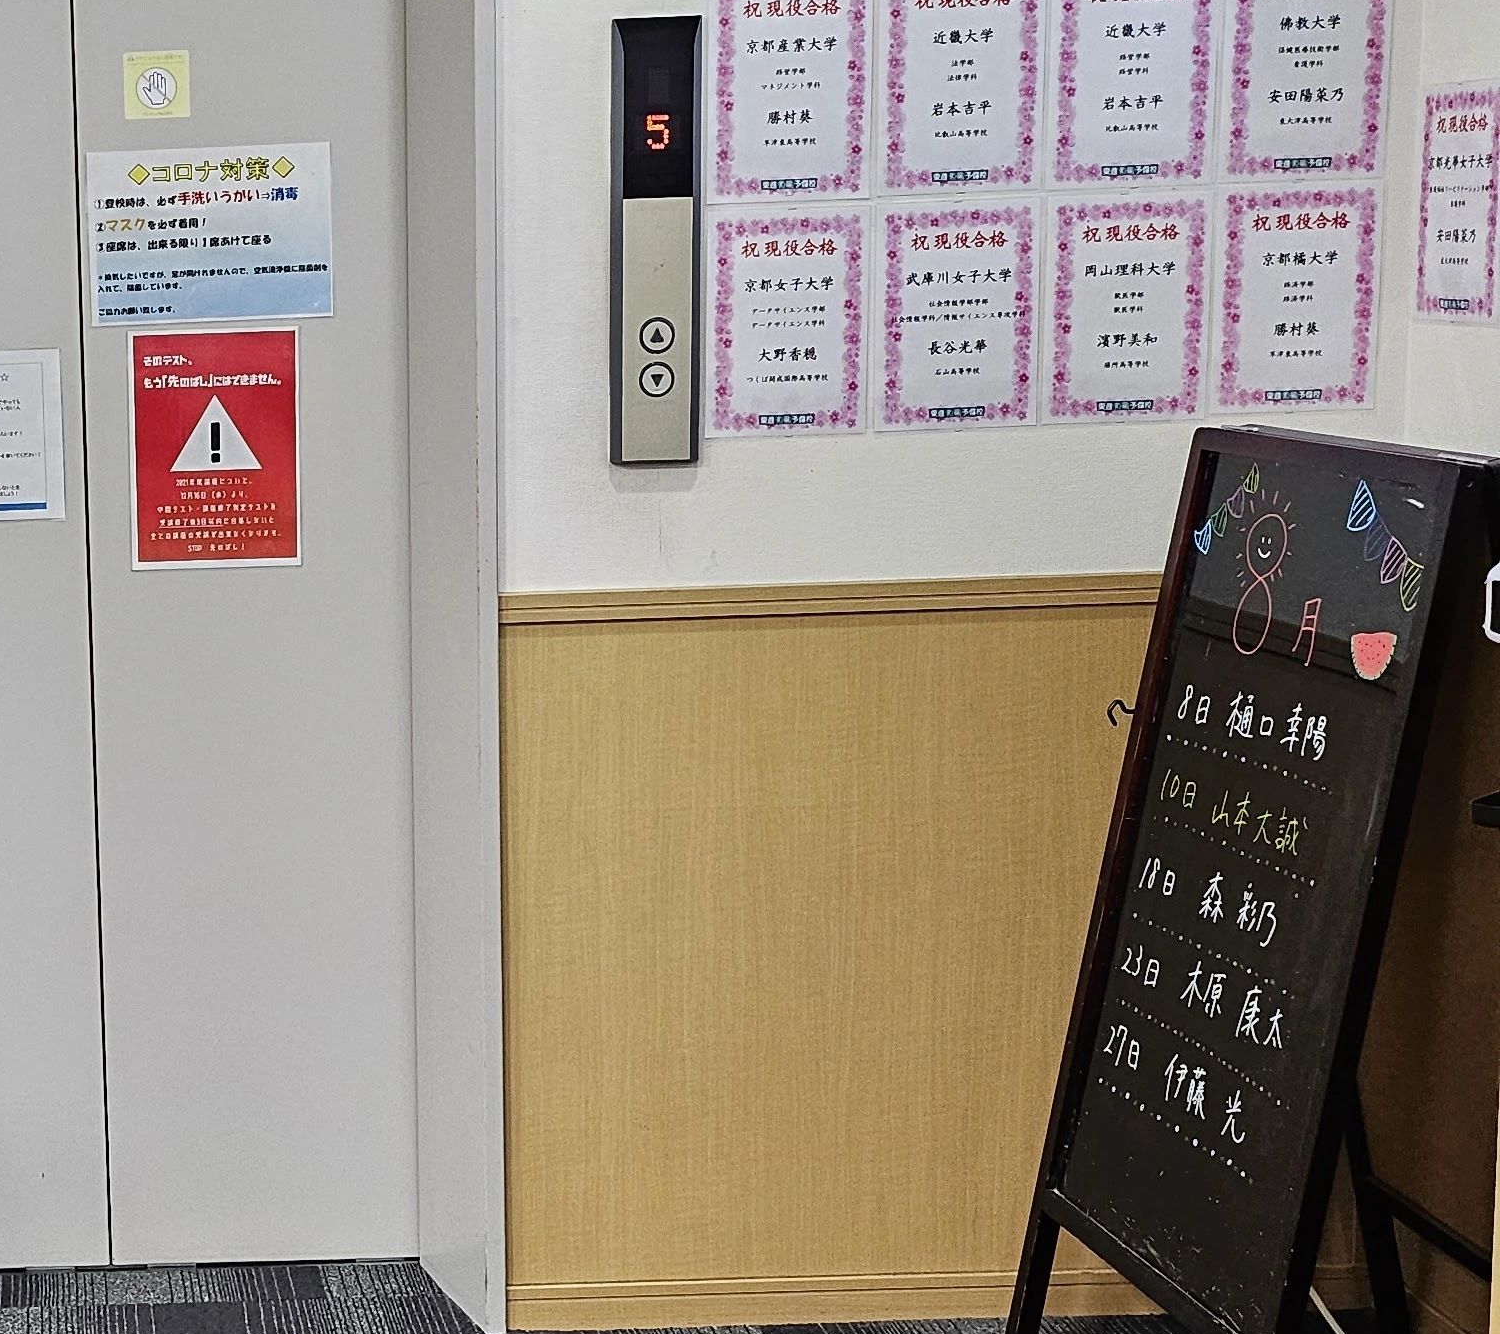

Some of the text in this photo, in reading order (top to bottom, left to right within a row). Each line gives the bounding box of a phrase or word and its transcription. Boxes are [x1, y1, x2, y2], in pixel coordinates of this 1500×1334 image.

[933, 28, 993, 44] 近畿大学
[1105, 22, 1166, 38] 近畿大学
[747, 36, 837, 54] 京都産業大学
[1102, 95, 1163, 110] 岩本吉平
[1268, 87, 1343, 103] 安田陽菜乃
[931, 100, 991, 116] 岩本吉平
[646, 114, 670, 150] 5
[152, 157, 269, 181] コロナ対策
[1263, 250, 1338, 266] 京都橘大学
[906, 268, 1011, 286] 武庫川女子大学
[1085, 261, 1175, 277] 岡山理科大学
[745, 276, 833, 292] 京都女子大学
[1274, 322, 1319, 336] 勝村葵
